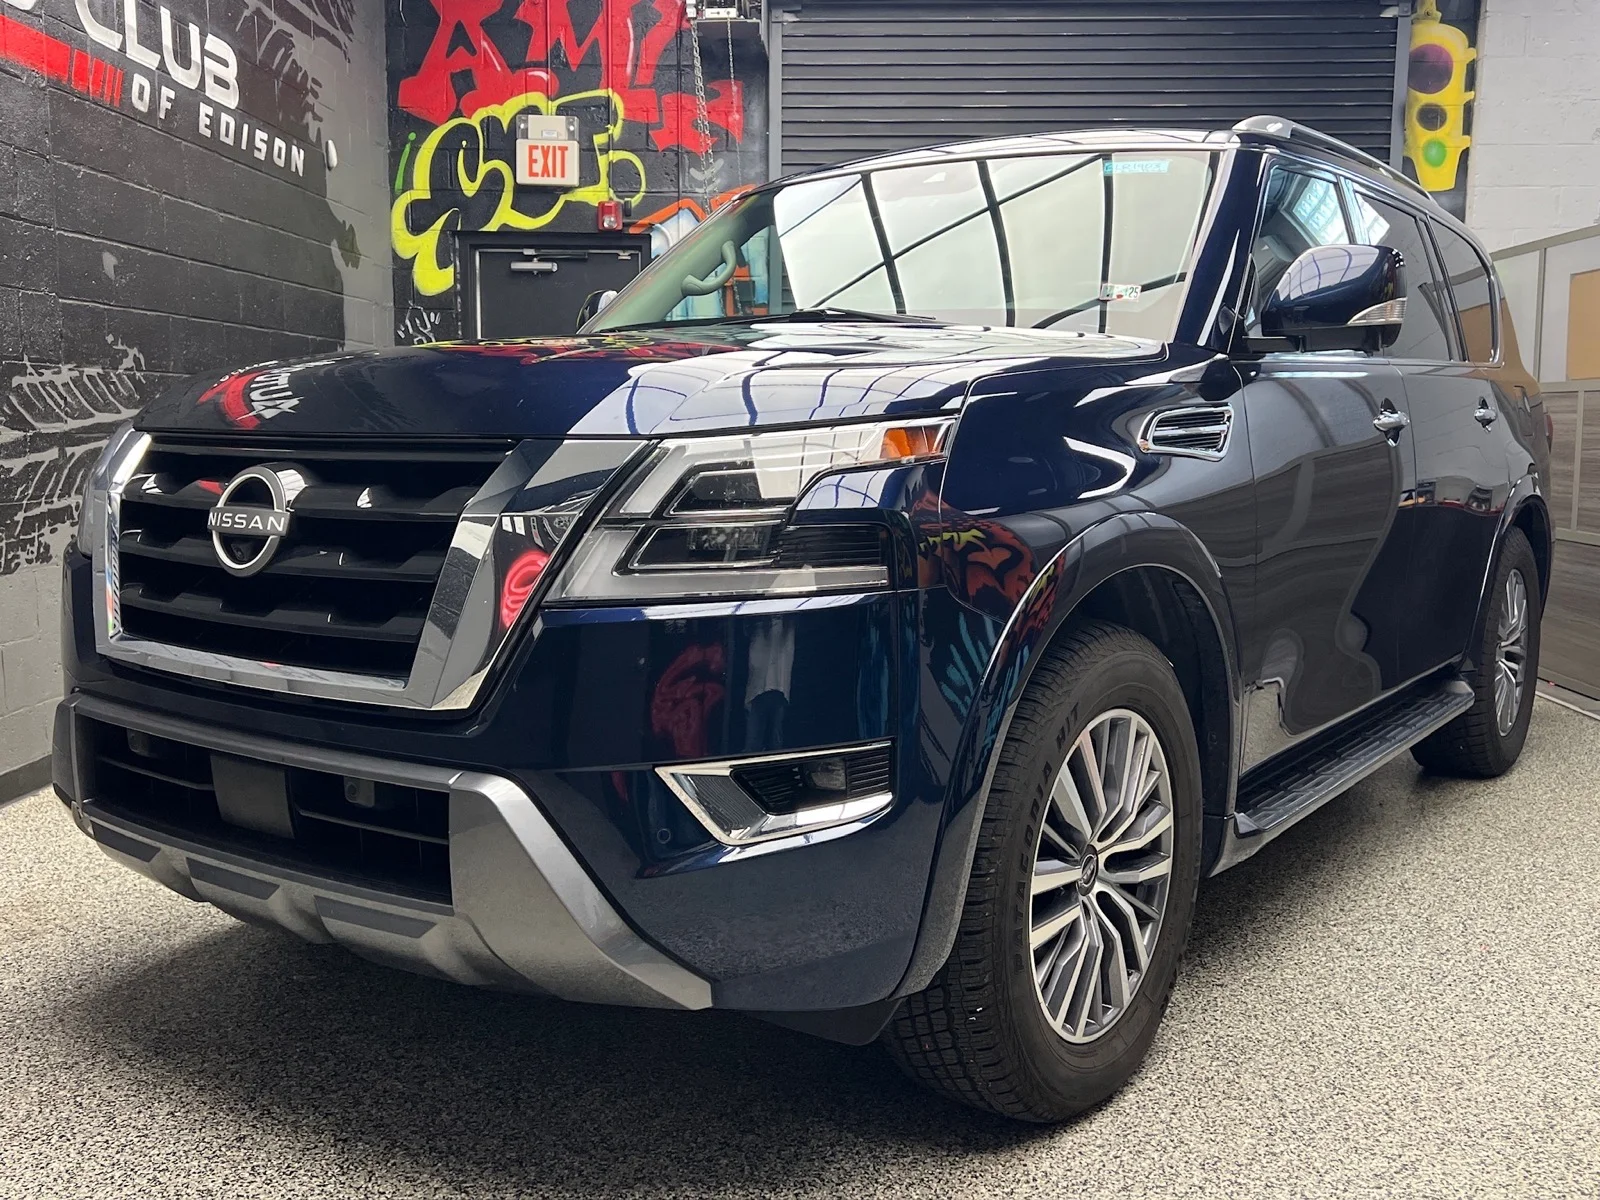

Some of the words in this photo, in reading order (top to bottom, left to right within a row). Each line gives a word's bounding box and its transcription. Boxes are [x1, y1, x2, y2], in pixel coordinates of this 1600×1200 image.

[131, 73, 176, 120] OF
[199, 101, 305, 177] EDISON
[527, 144, 569, 179] EXIT
[207, 512, 285, 532] NISSAN
